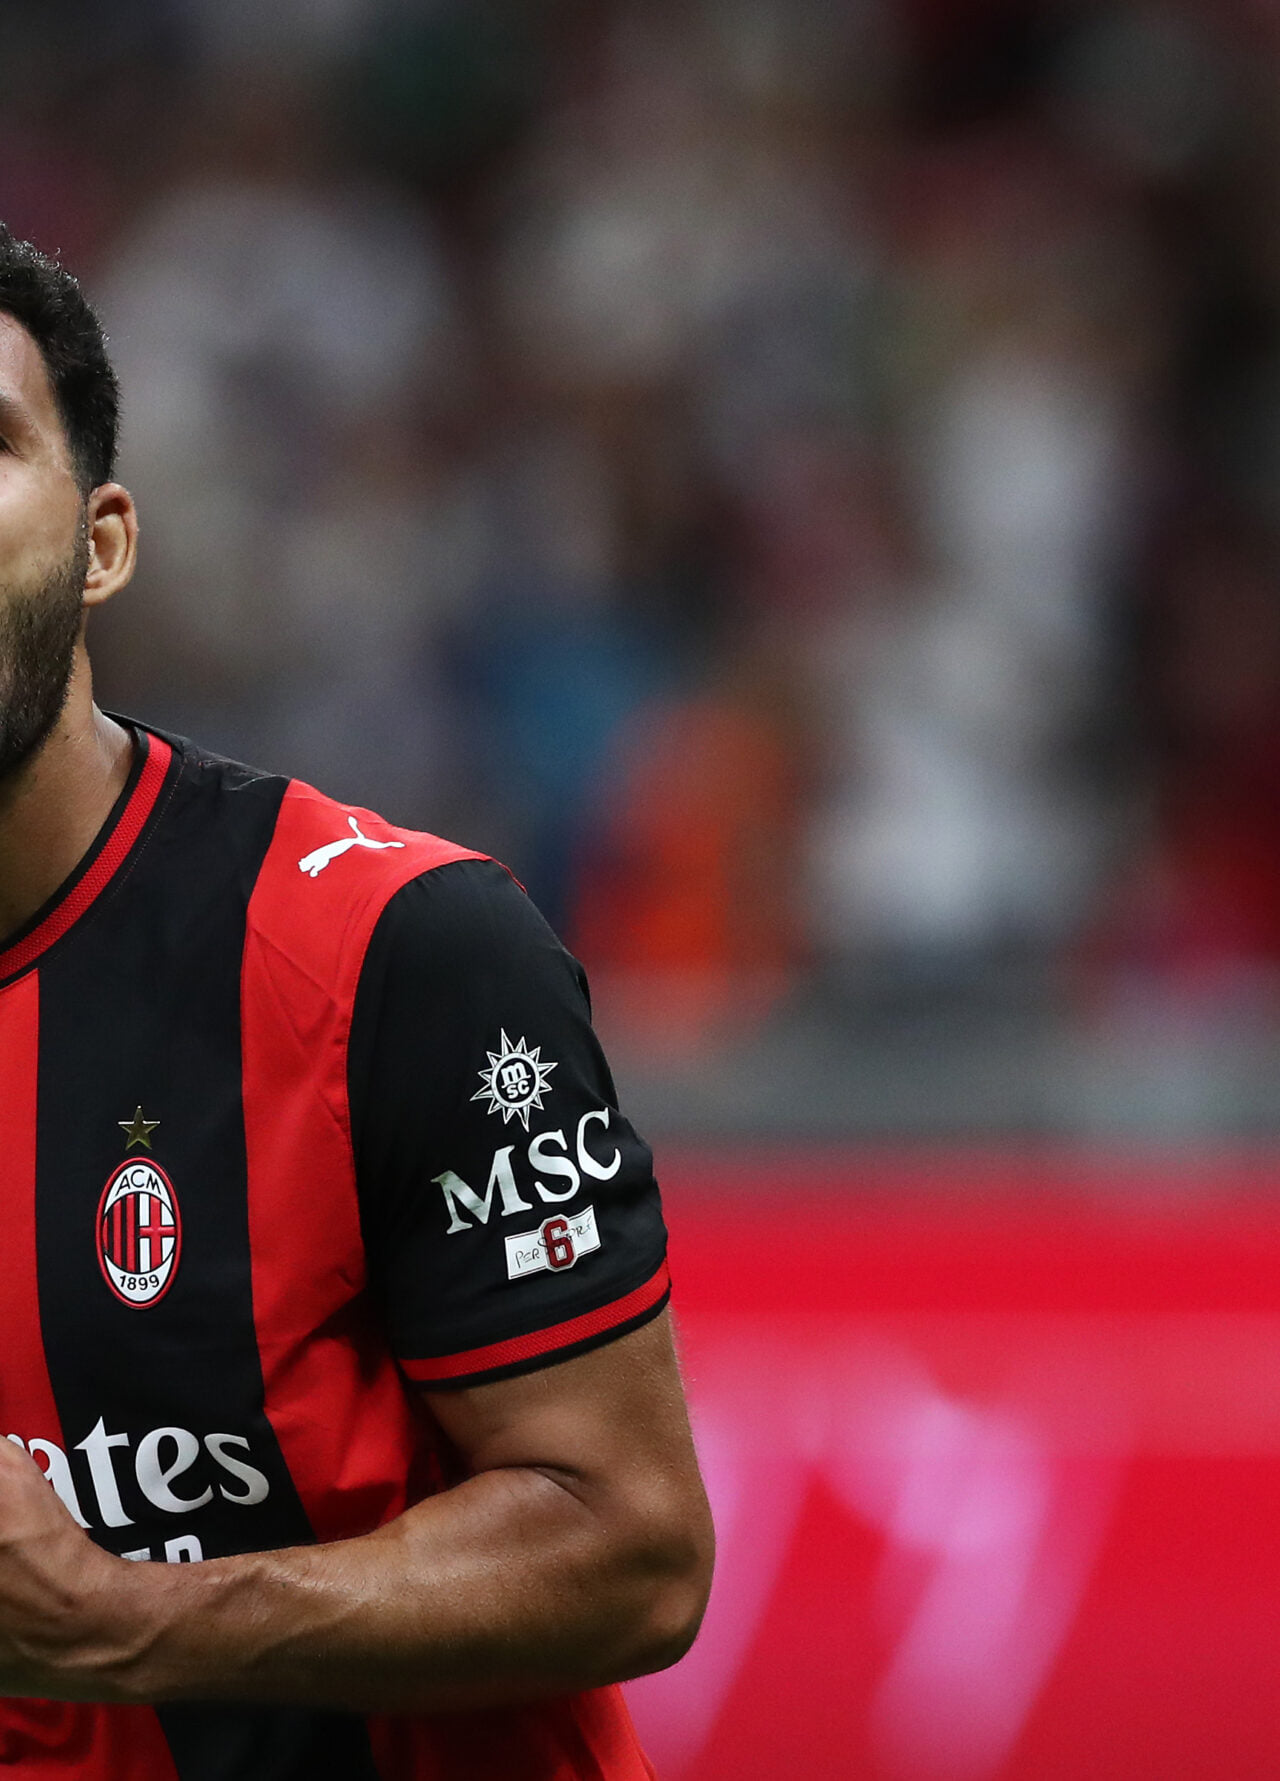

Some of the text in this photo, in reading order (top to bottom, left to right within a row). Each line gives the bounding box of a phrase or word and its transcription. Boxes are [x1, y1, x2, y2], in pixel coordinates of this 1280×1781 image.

[116, 1169, 162, 1197] ACM
[431, 1107, 621, 1234] MSC
[543, 1218, 574, 1268] 6
[119, 1274, 160, 1291] 1899
